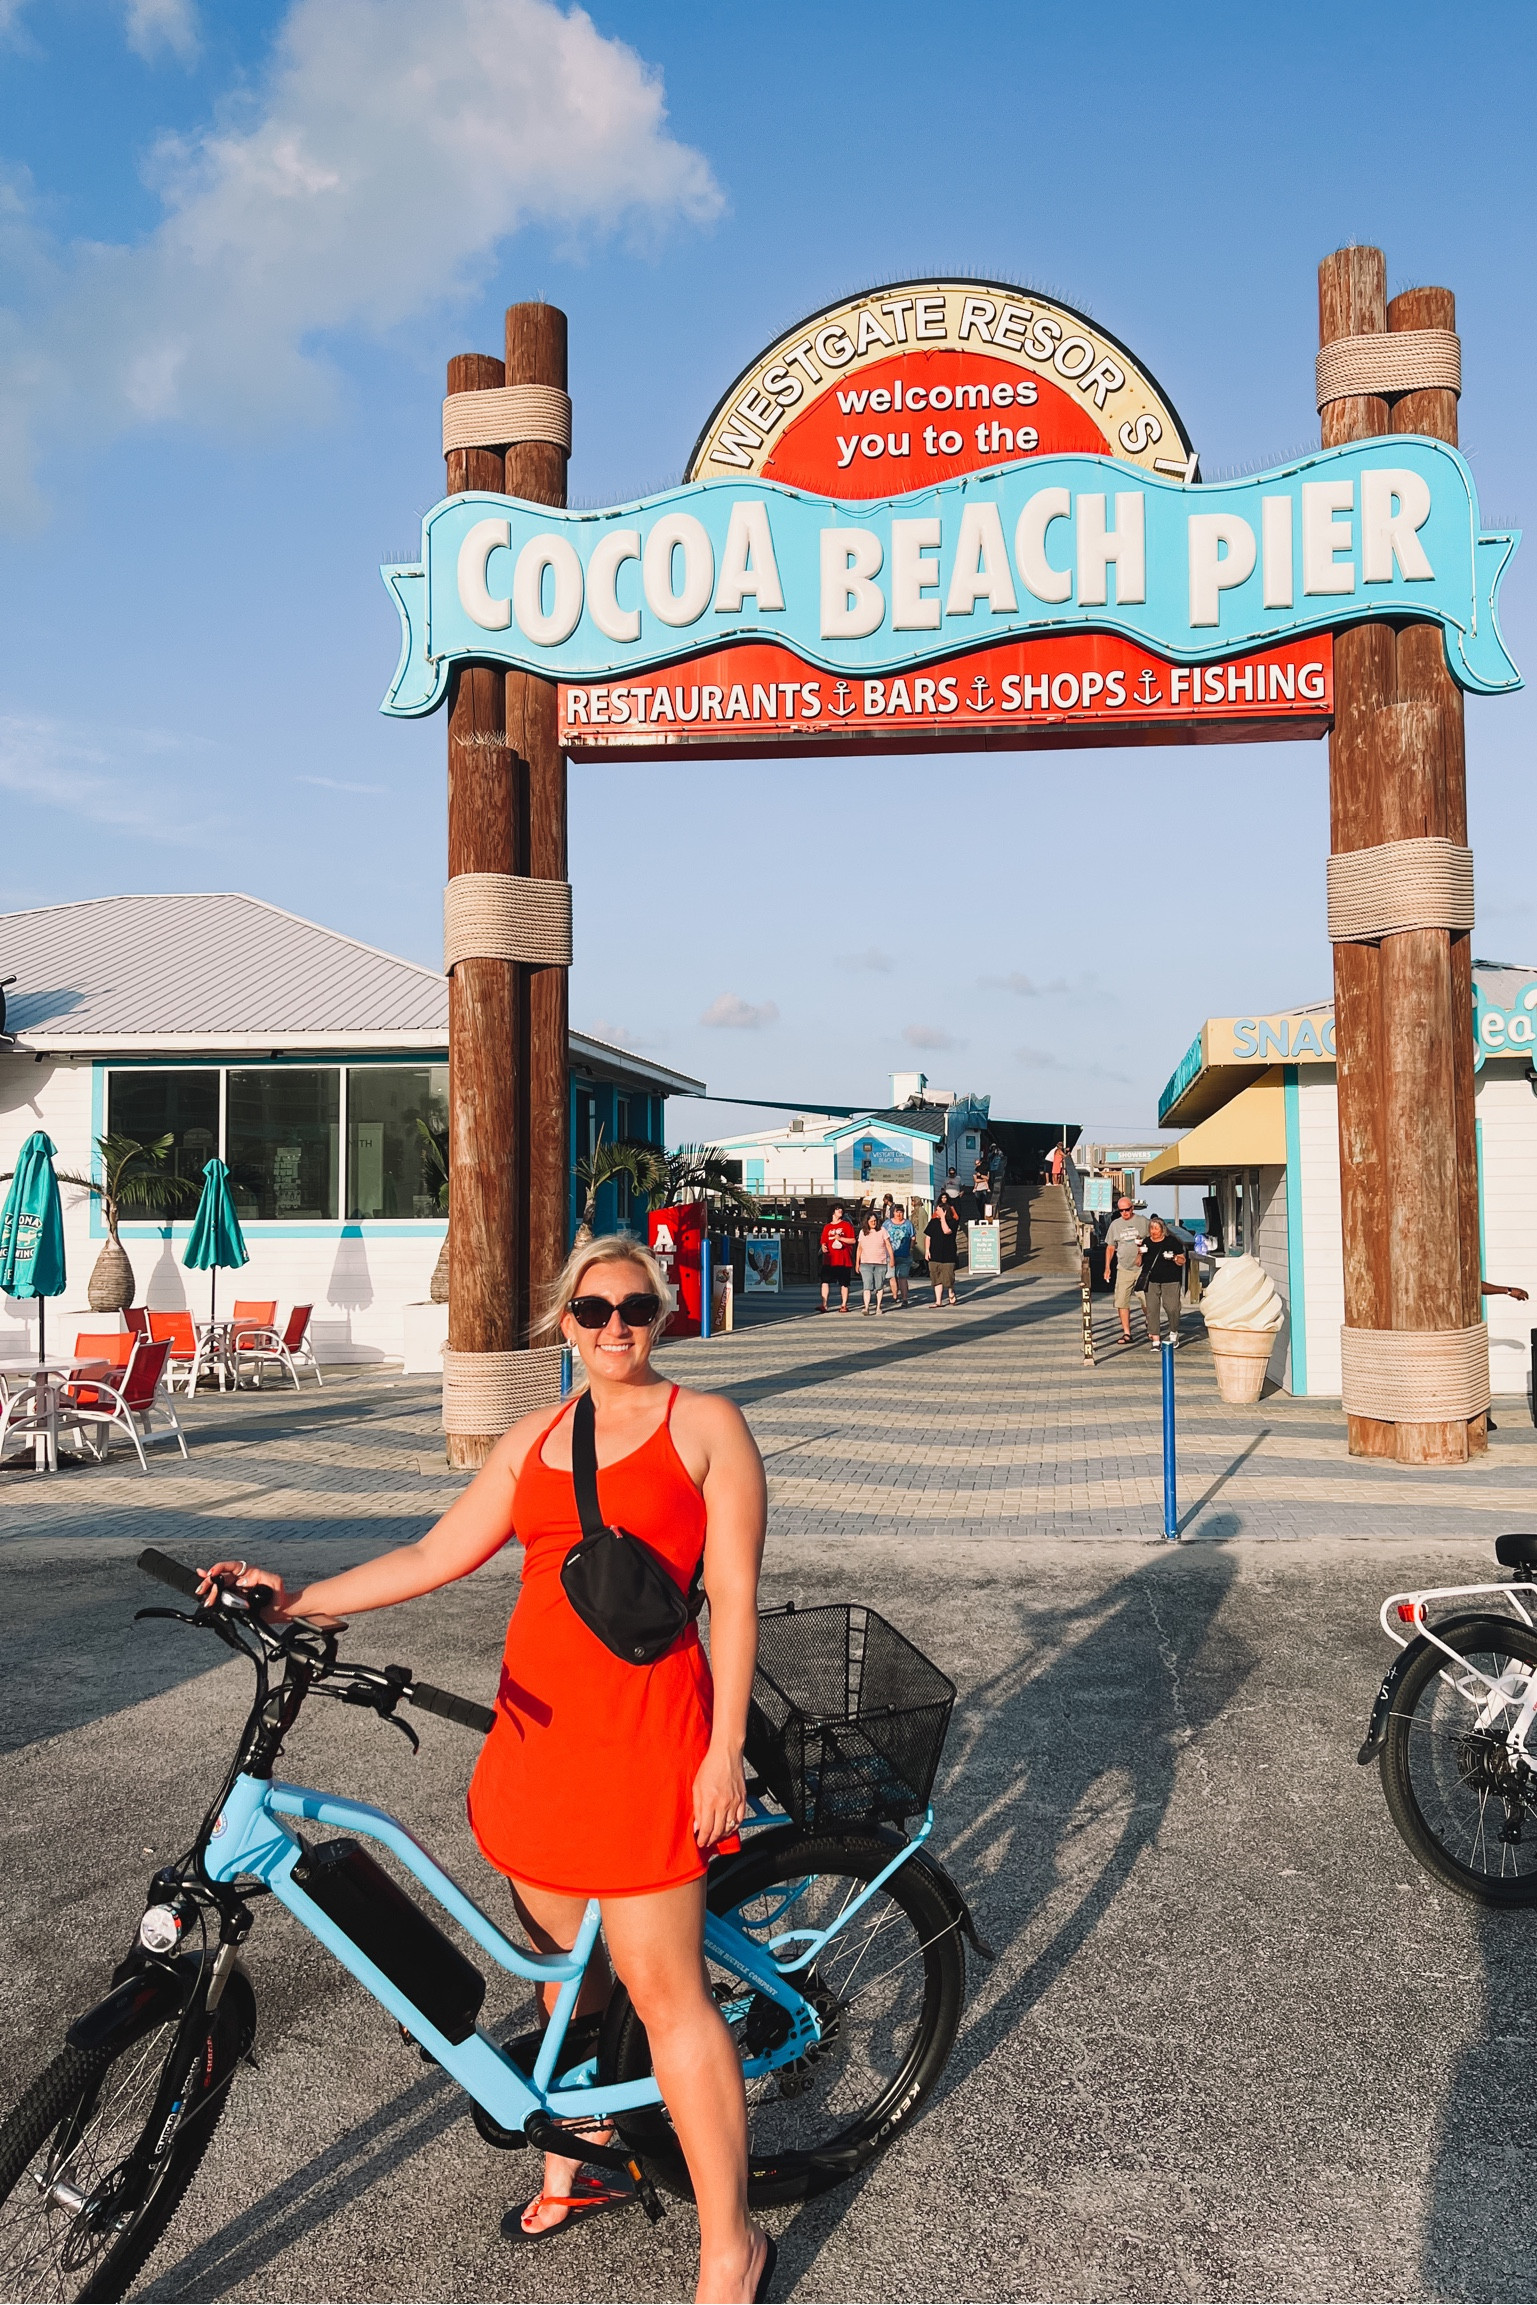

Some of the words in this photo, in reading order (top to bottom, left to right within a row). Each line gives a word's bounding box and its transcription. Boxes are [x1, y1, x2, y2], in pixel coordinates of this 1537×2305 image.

[709, 297, 948, 470] WESTGATE
[835, 380, 1039, 416] welcomes
[836, 431, 912, 469] you
[922, 424, 965, 457] to
[974, 420, 1040, 454] the
[457, 500, 787, 647] COCOA
[819, 487, 1147, 640] BEACH
[1188, 468, 1436, 629] PIER
[566, 681, 822, 725] RESTAURANTS
[864, 676, 959, 716] BARS
[1001, 669, 1127, 712] SHOPS
[1170, 662, 1326, 705] FISHING
[714, 1307, 724, 1326] PLAY
[1082, 1287, 1093, 1355] ENTER
[703, 1938, 725, 1956] BEACH
[723, 1952, 749, 1974] BICYCLE
[748, 1971, 778, 1996] COMPANY
[868, 2081, 921, 2146] KENDA
